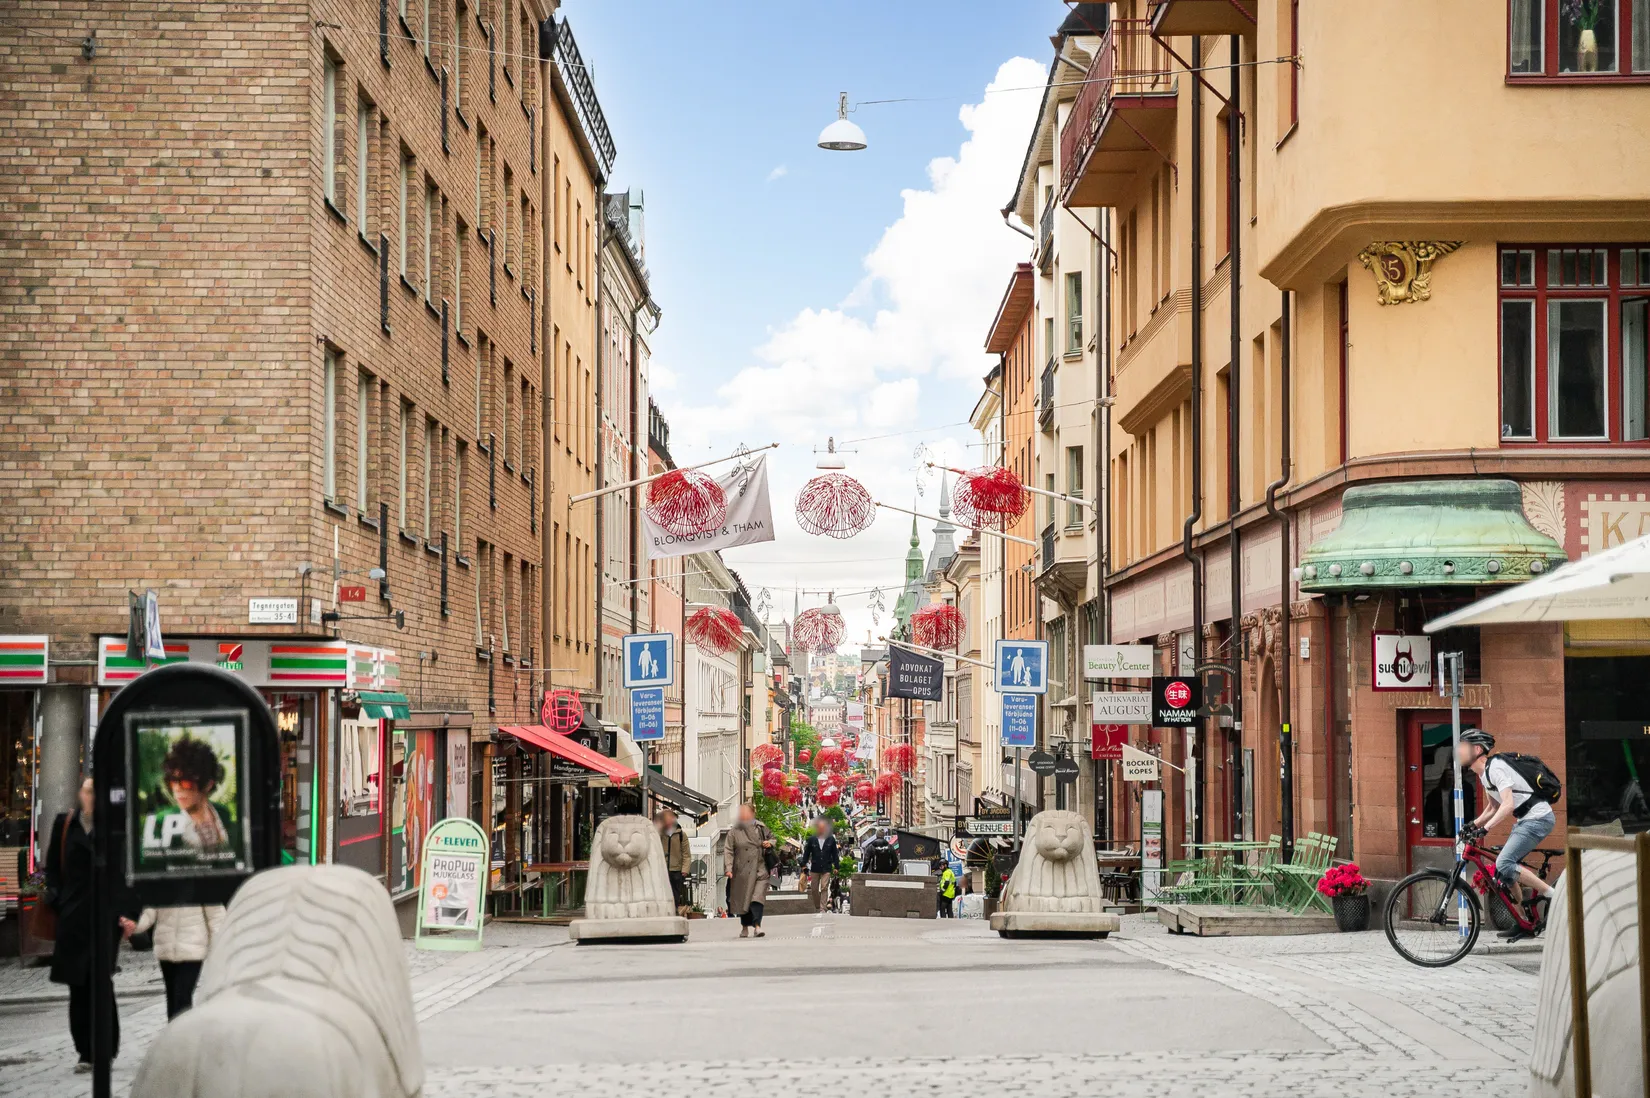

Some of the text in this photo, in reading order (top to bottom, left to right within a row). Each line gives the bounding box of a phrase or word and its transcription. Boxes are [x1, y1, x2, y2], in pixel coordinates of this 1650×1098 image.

[653, 520, 764, 546] BLOMQVIST & THAM
[274, 613, 295, 621] 35-41
[900, 663, 933, 673] ADVOKAT
[1088, 661, 1150, 672] Beauty Center
[899, 674, 932, 684] BOLAGET
[912, 686, 932, 696] OPUS
[1005, 710, 1033, 718] förbjudna
[1100, 706, 1148, 715] AUGUST
[1159, 709, 1196, 718] NAMAMI
[1126, 759, 1155, 767] BÖCKER
[432, 872, 475, 880] MJUKGLASS
